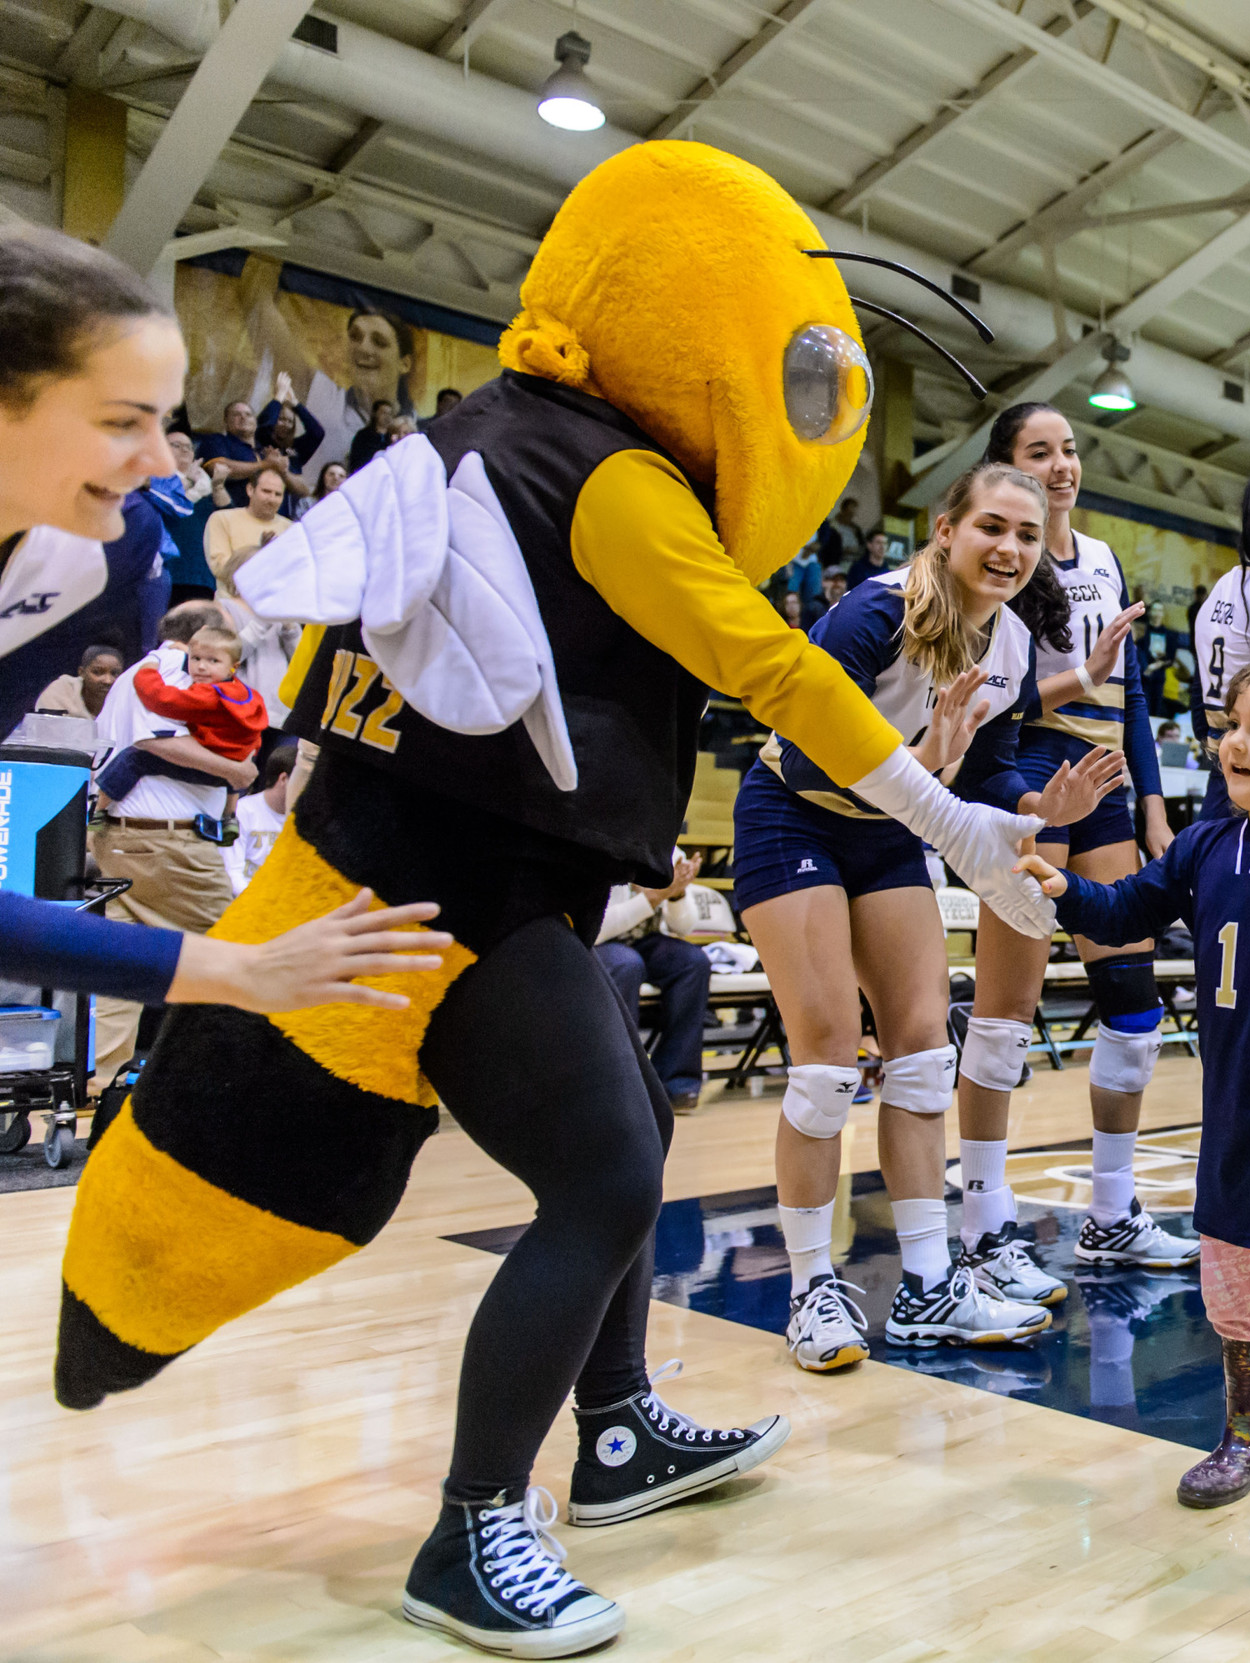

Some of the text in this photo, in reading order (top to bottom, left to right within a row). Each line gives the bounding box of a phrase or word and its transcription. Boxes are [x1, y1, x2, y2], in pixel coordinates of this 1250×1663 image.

[1064, 584, 1102, 602] ECH
[986, 675, 1010, 687] ACC
[1206, 636, 1225, 699] 9
[0, 772, 12, 888] OWERADE
[1215, 921, 1239, 1010] 1
